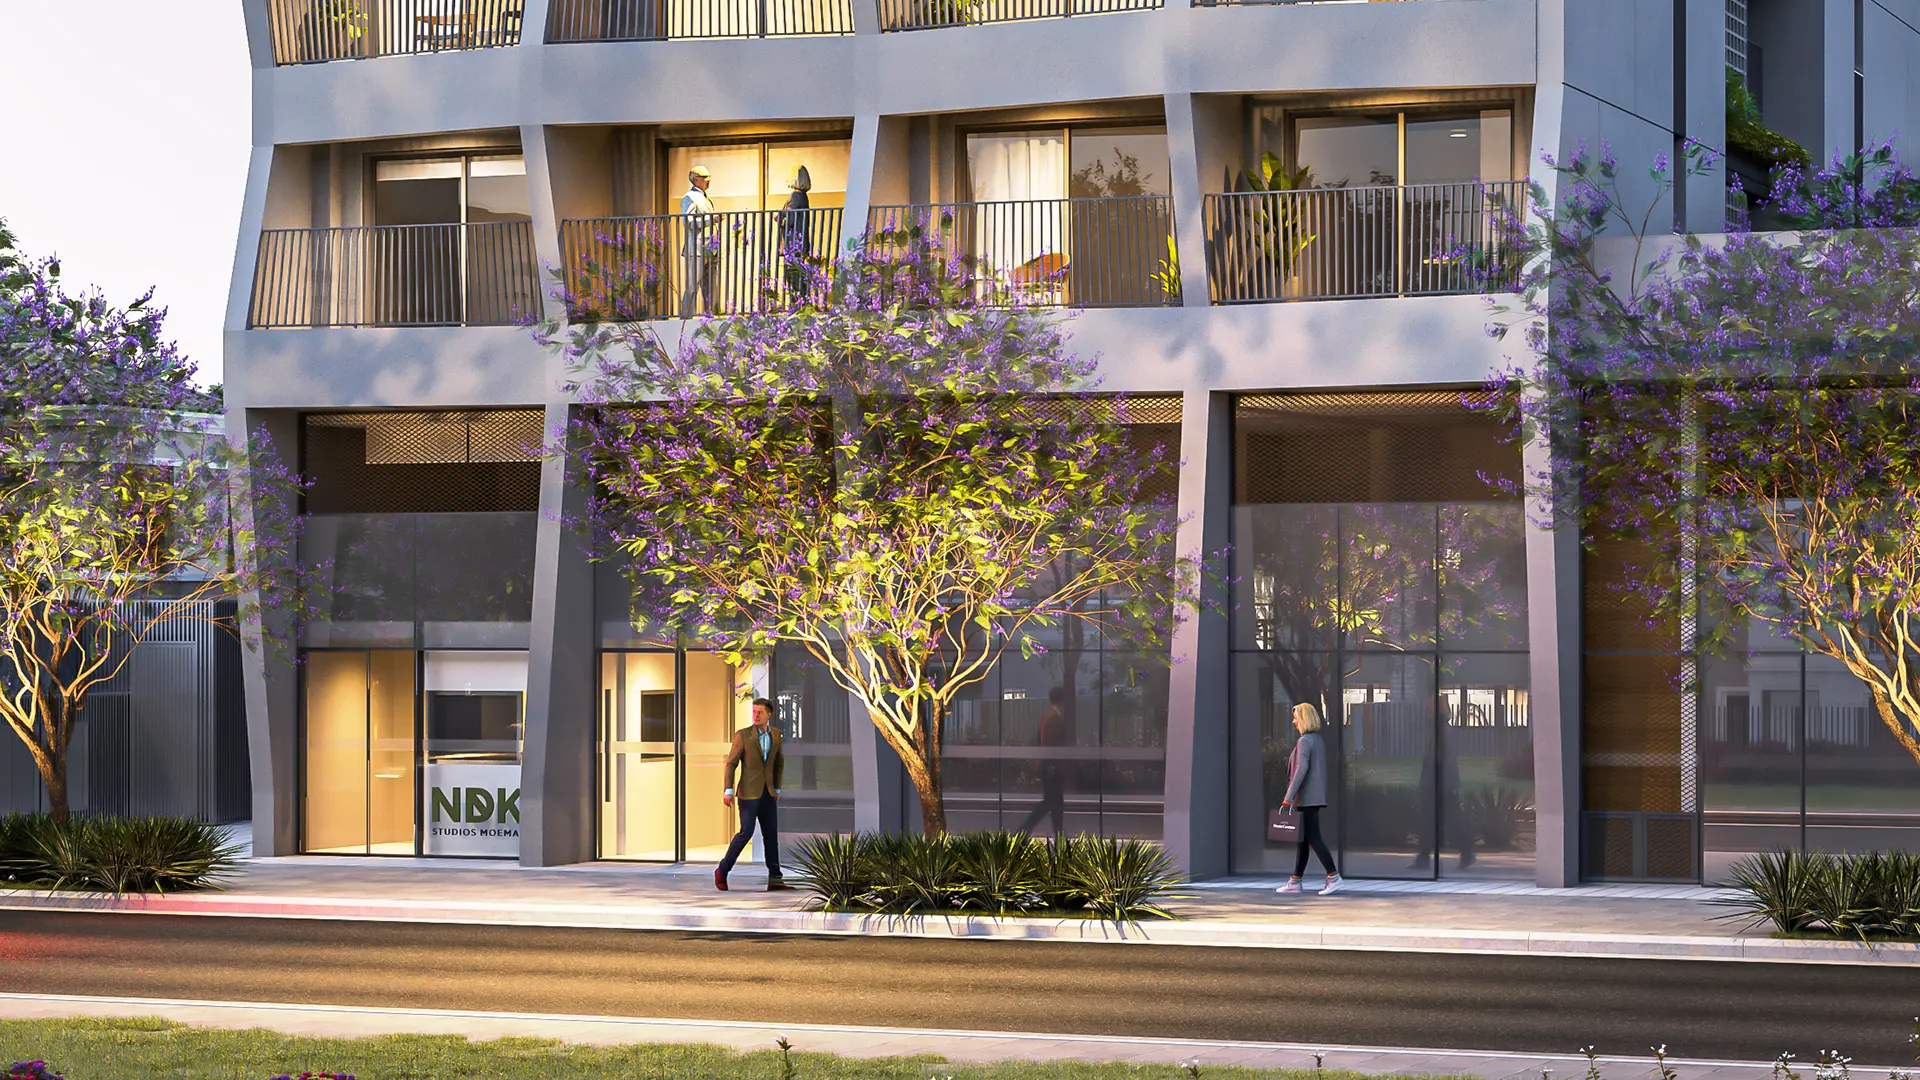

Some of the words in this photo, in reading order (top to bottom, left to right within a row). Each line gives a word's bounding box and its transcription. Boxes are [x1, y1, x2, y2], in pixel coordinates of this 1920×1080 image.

[432, 787, 520, 824] NDK
[432, 828, 477, 836] STUDIOS
[480, 829, 519, 837] MOEMA
